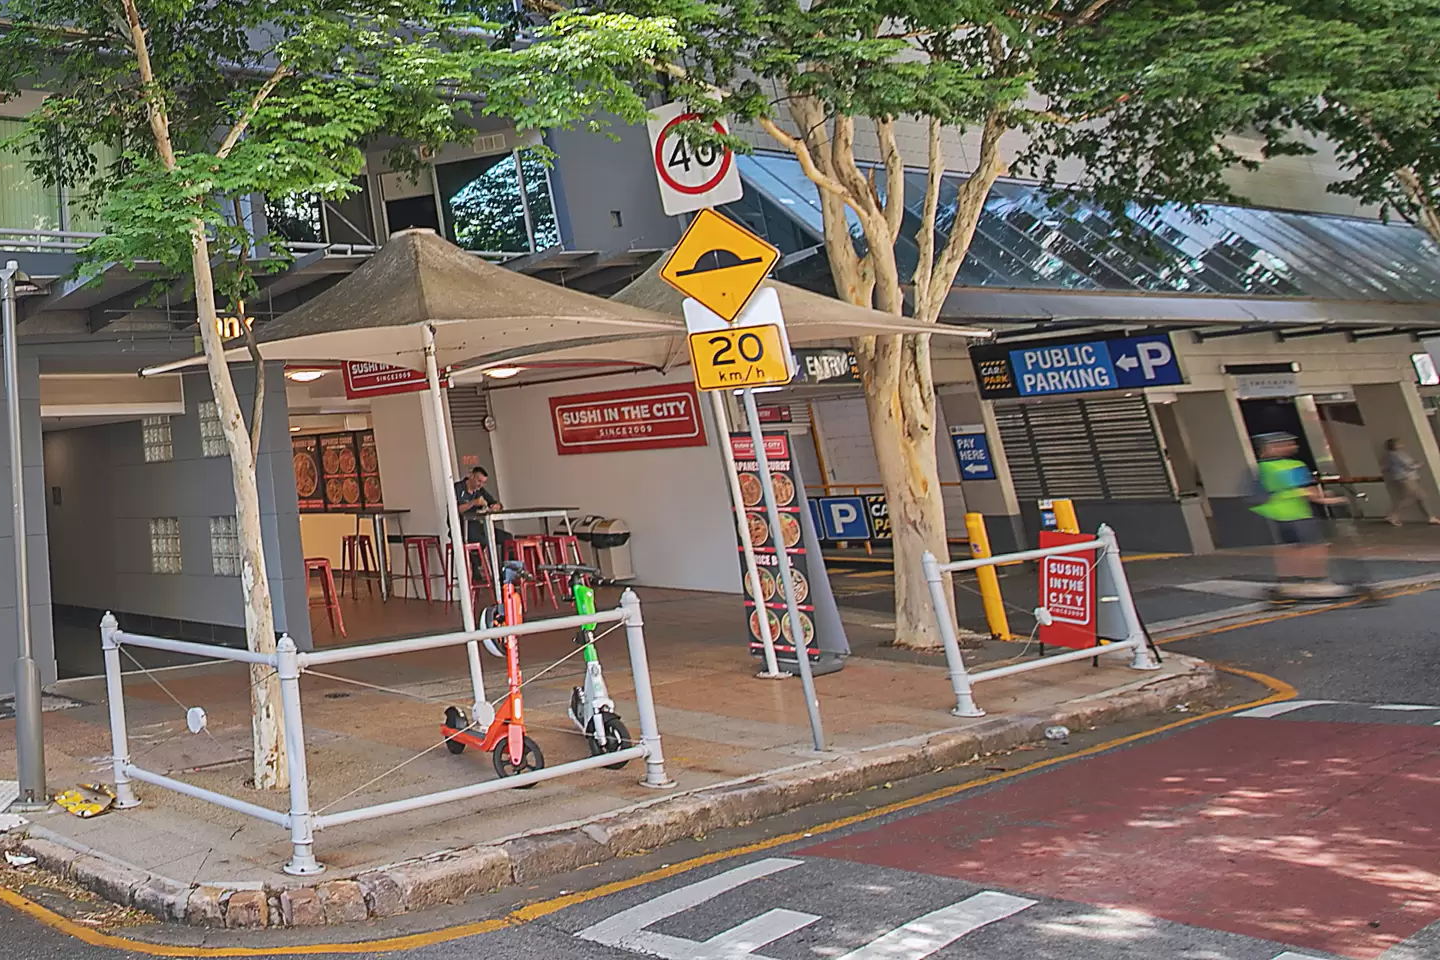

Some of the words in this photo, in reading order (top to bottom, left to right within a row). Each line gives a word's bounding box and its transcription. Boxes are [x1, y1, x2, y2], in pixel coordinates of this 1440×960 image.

[668, 138, 717, 172] 40
[709, 333, 764, 366] 20
[1025, 345, 1096, 370] PUBLIC
[1137, 342, 1172, 379] P
[719, 365, 765, 381] km/h
[984, 375, 1008, 383] PARK
[1023, 367, 1110, 392] PARKING
[563, 410, 601, 424] SUSHI
[604, 409, 619, 421] IN
[621, 405, 650, 419] THE
[653, 401, 686, 416] CITY
[599, 425, 653, 436] SINCE2009
[957, 438, 975, 449] PAY
[960, 450, 986, 460] HERE
[831, 503, 857, 533] P
[871, 504, 888, 517] CA
[875, 519, 890, 530] PA
[1049, 563, 1084, 576] SUSHI
[1049, 593, 1084, 606] CITY
